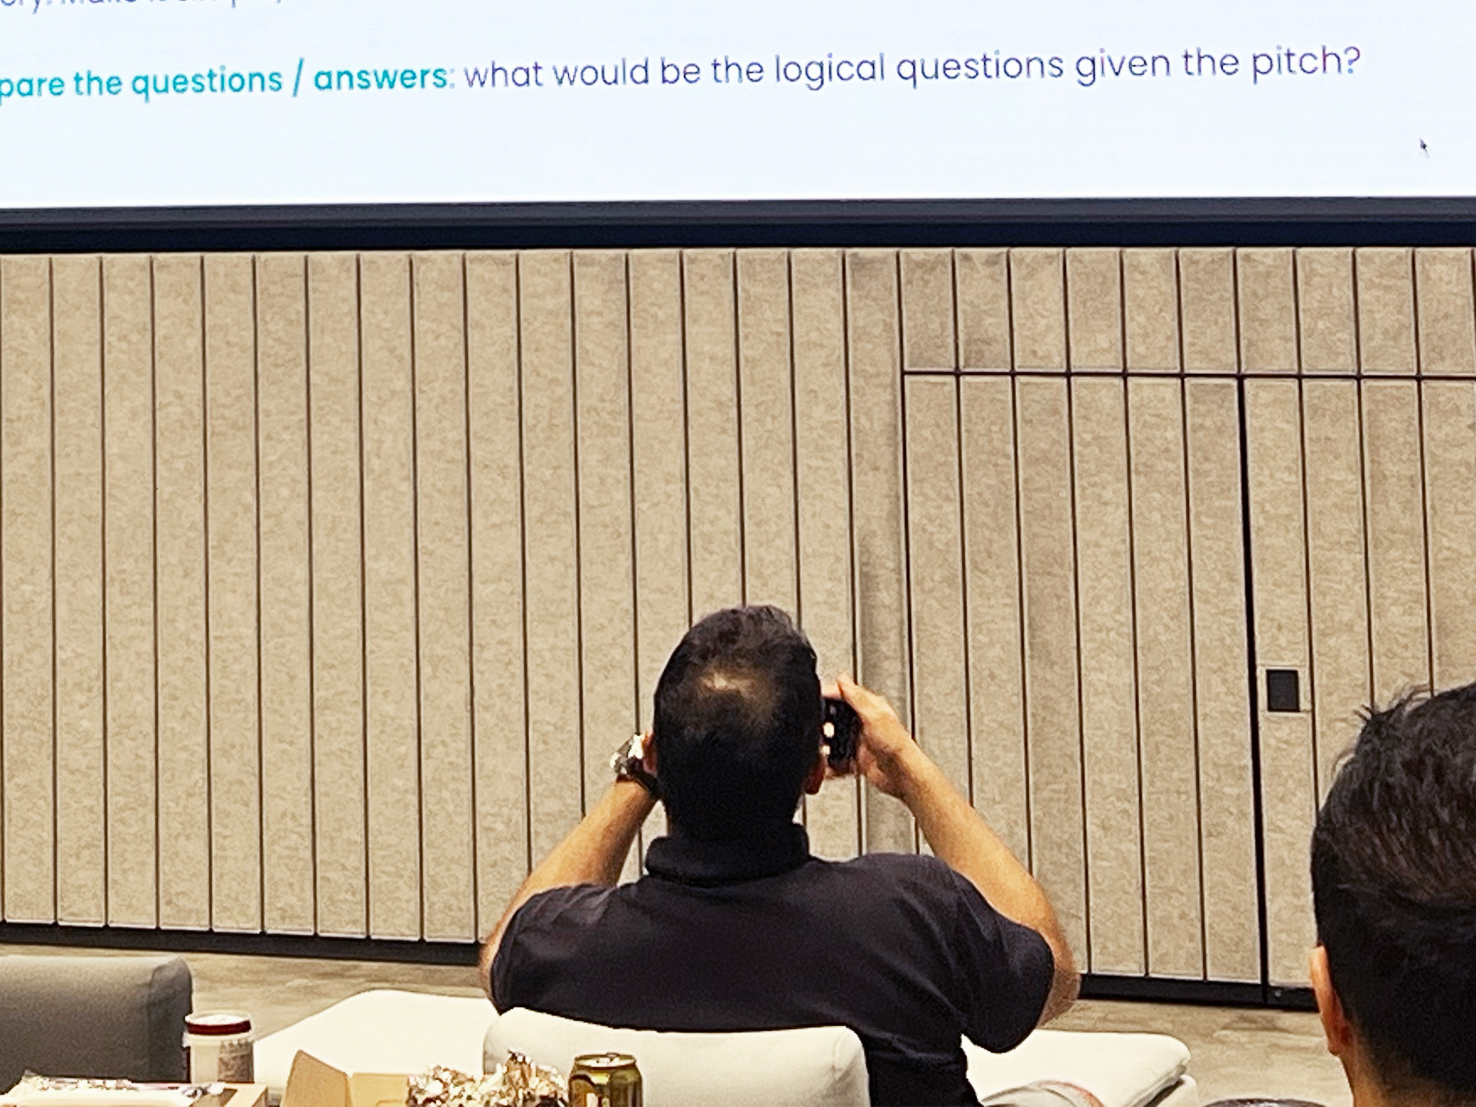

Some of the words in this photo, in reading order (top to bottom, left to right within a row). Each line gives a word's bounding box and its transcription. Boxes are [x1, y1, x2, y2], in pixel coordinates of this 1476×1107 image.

[73, 70, 123, 96] the
[131, 65, 283, 104] questions
[292, 57, 304, 97] /
[313, 68, 455, 91] answers:
[464, 60, 543, 88] what
[552, 57, 649, 86] would
[661, 57, 700, 84] be
[711, 55, 764, 83] the
[775, 53, 884, 91] logical
[897, 50, 1063, 90] questions
[1076, 48, 1171, 87] given
[1182, 47, 1239, 76] the
[1253, 45, 1360, 85] pitch?
